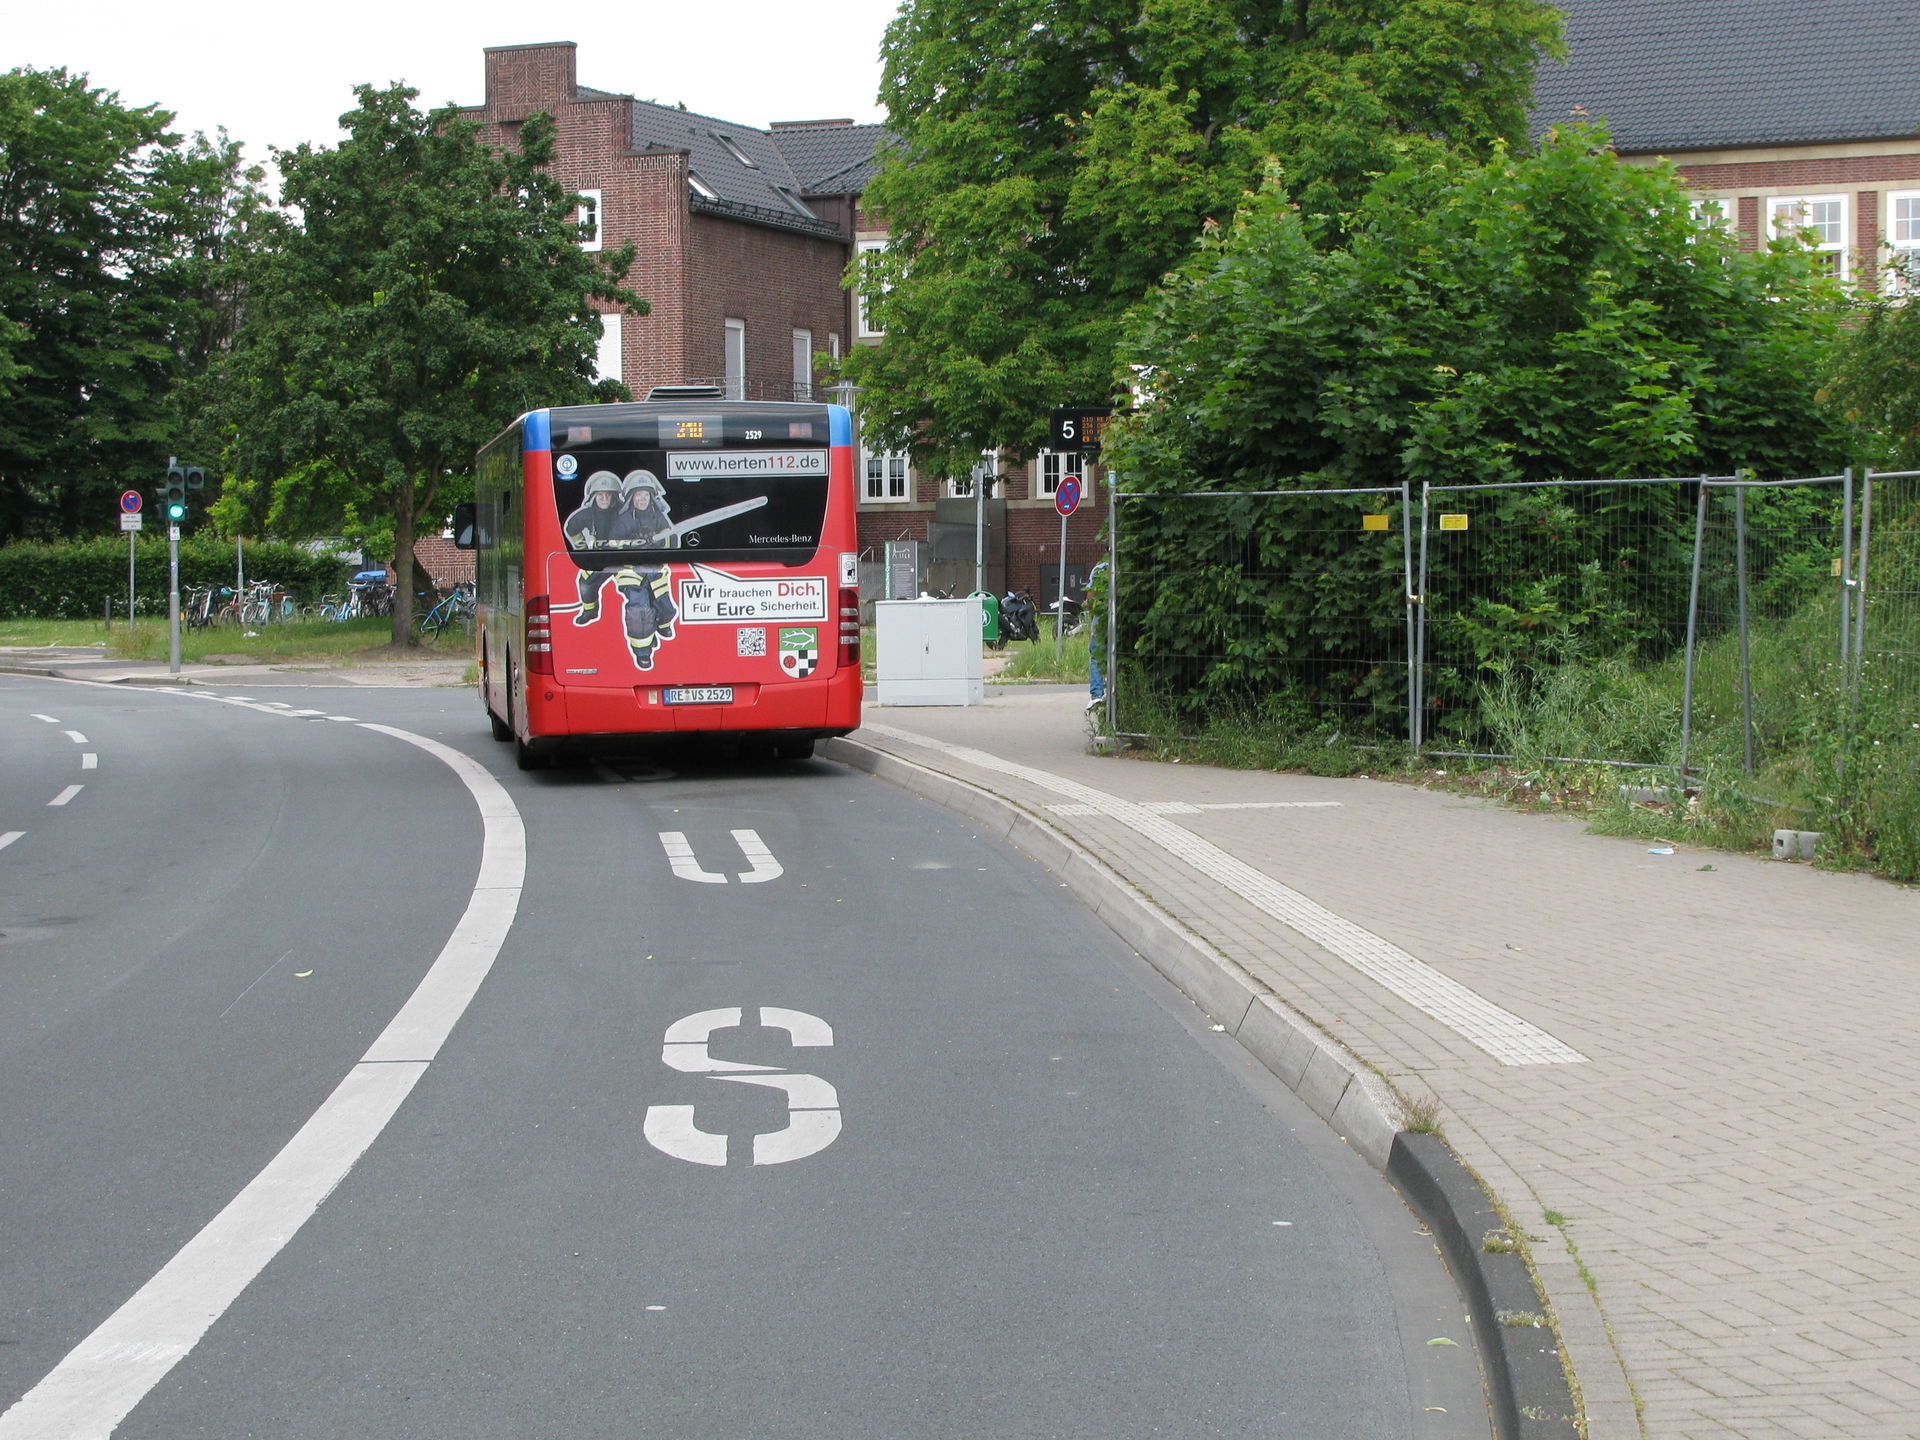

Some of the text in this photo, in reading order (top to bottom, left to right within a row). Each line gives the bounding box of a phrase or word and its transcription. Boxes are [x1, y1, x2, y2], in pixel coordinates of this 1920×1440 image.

[745, 430, 762, 440] 2529
[1062, 420, 1075, 439] 5
[675, 455, 820, 471] www.herten112.de
[749, 534, 812, 543] Mercedes-Benz
[686, 582, 820, 599] Wir brauchen Dich.
[693, 600, 819, 616] Für Eure Sicherheit.
[671, 689, 731, 701] RE VS 2529
